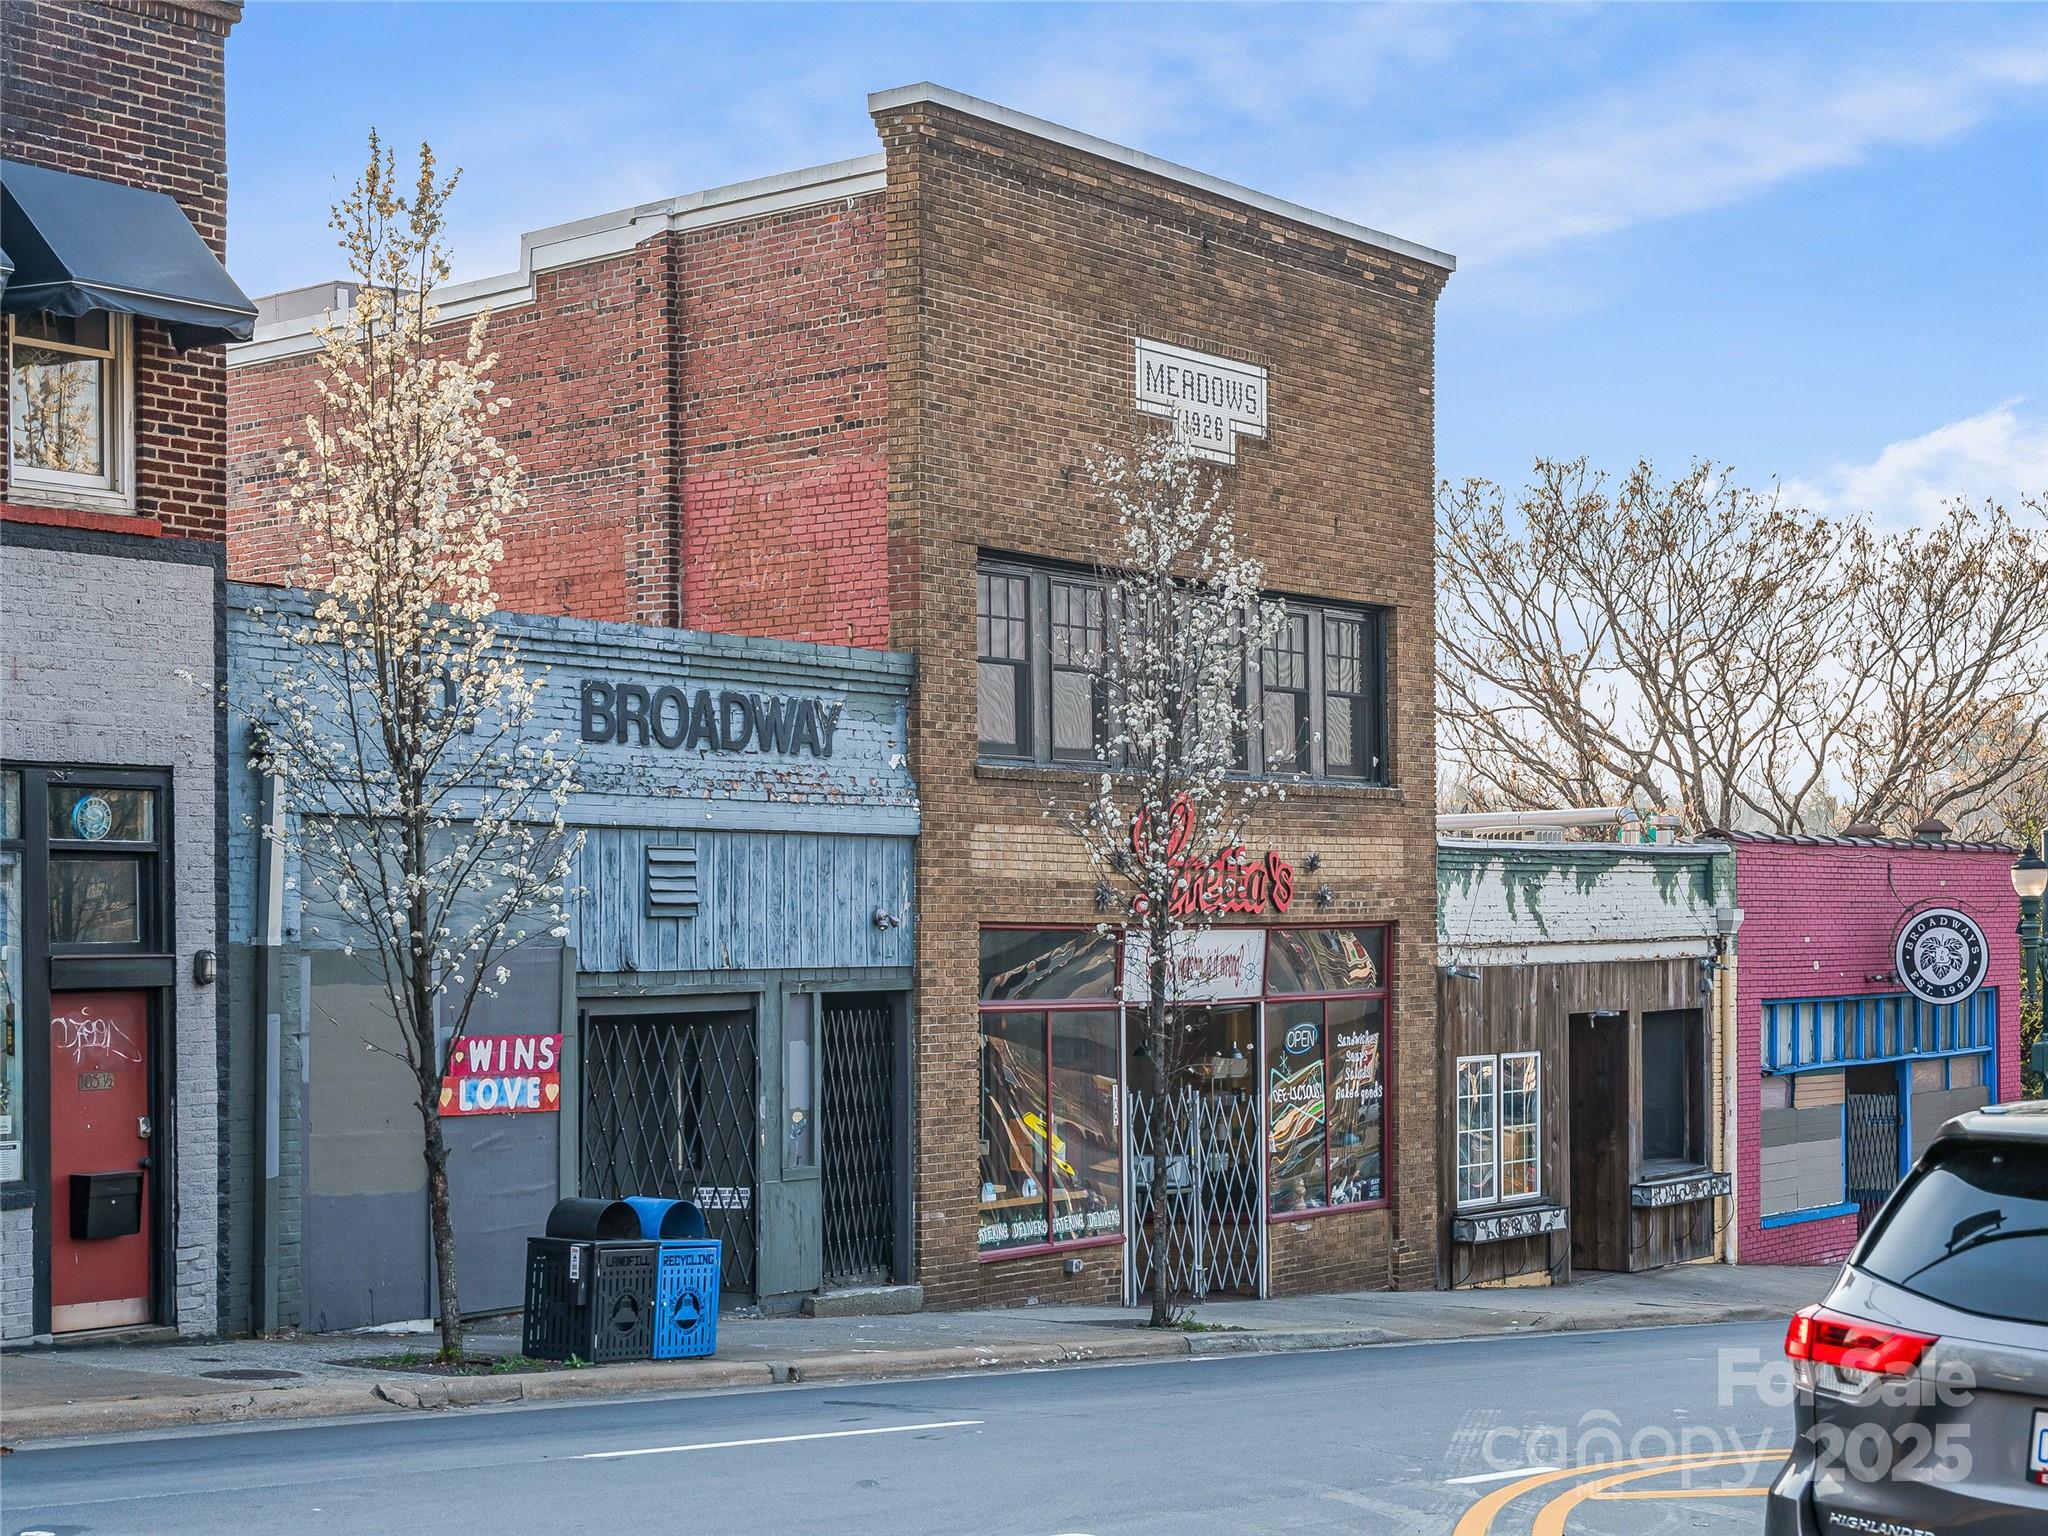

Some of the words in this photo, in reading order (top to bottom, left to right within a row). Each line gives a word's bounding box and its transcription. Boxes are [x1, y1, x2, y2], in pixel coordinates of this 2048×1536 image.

[1184, 410, 1223, 441] 1926
[581, 679, 846, 757] BROADWAY
[1905, 917, 1980, 954] BROADWAYS
[1910, 971, 1933, 995] EST.
[1942, 975, 1971, 996] 1999
[1287, 1030, 1315, 1048] OPEN
[469, 1037, 554, 1072] WINS
[80, 1074, 100, 1089] 105
[459, 1077, 541, 1111] LOVE
[1011, 1219, 1048, 1239] DELIVERY
[1086, 1209, 1121, 1229] DELIVERY
[606, 1255, 651, 1267] LANDFILL
[663, 1254, 715, 1267] RECYCLING
